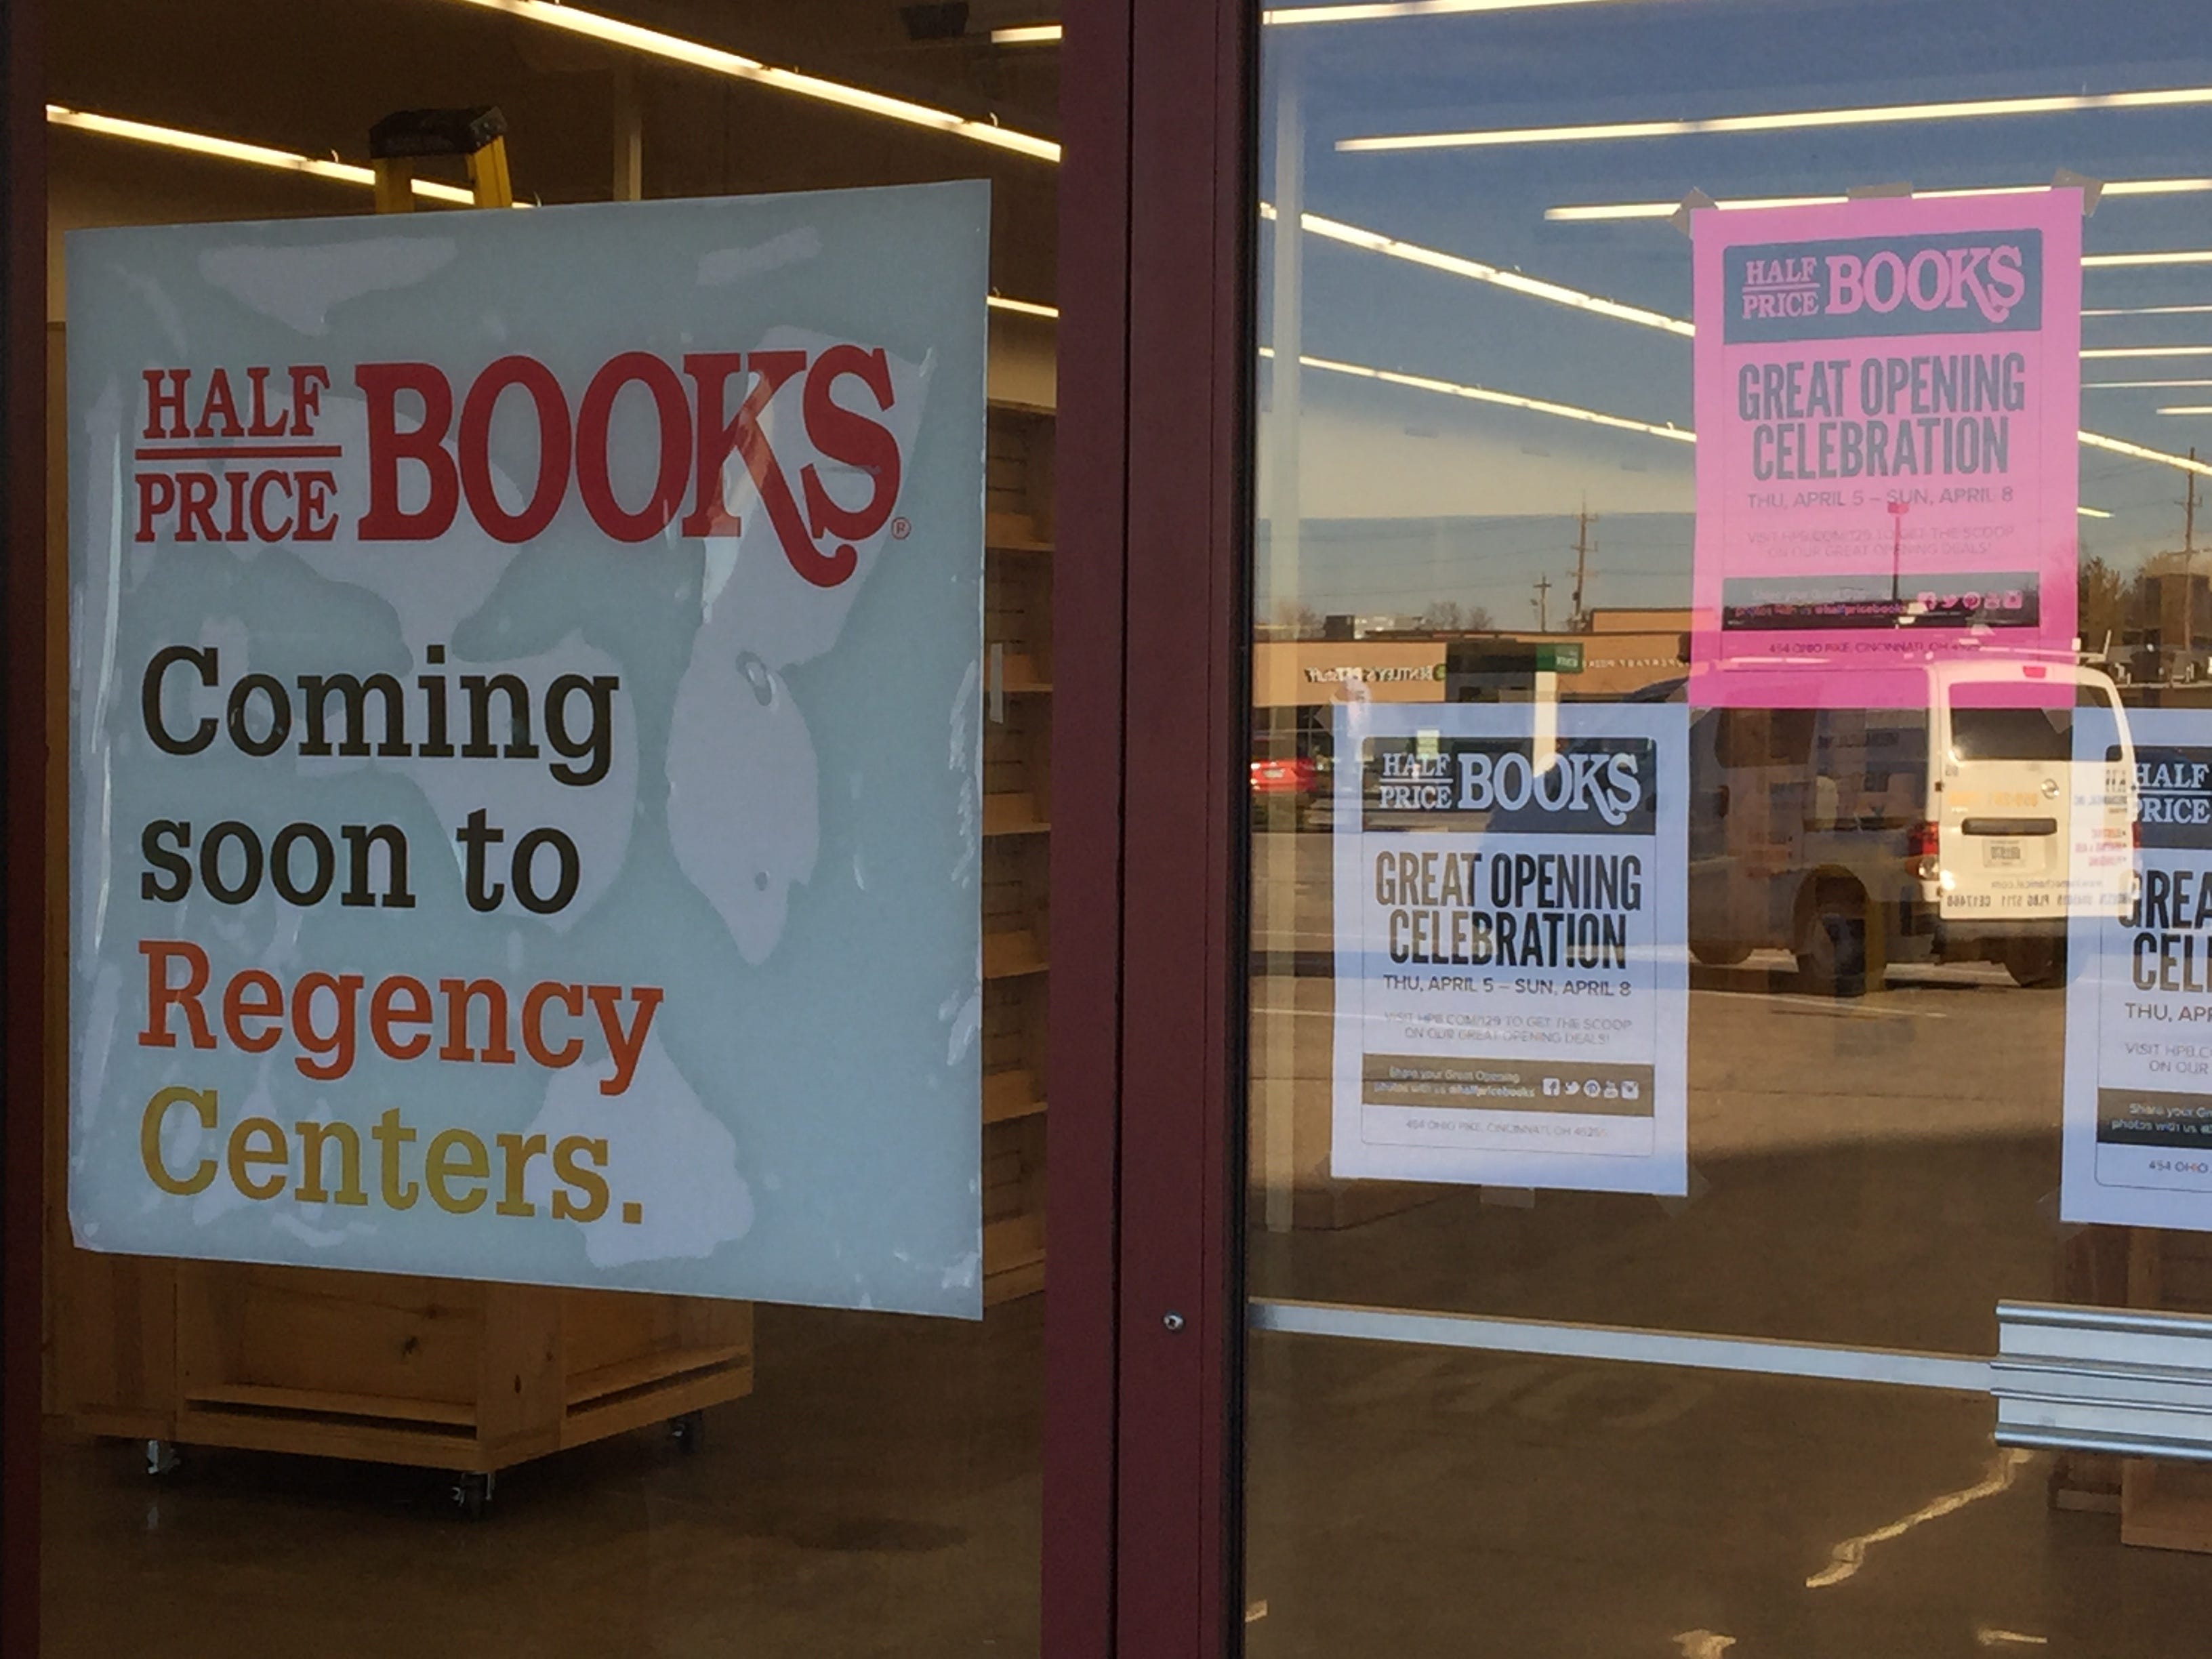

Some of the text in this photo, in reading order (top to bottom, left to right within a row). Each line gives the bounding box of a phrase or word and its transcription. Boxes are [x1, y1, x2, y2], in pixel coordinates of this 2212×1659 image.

[1746, 257, 1817, 284] HALF
[1825, 245, 2025, 323] BOOKS
[1742, 291, 1819, 319] PRICE
[142, 365, 331, 438] HALF
[1738, 352, 2026, 421] GREAT OPENING
[354, 344, 901, 588] BOOKS
[1753, 415, 2009, 481] CELEBRATION
[135, 470, 338, 543] PRICE
[1748, 493, 1788, 510] THU,
[1793, 491, 1845, 508] APRIL
[1851, 490, 1864, 506] 5
[1886, 488, 1933, 506] SUN,
[1939, 487, 1994, 504] APRIL
[2001, 486, 2014, 502] 8
[142, 644, 620, 787] Coming
[1382, 752, 1451, 777] HALF
[1457, 752, 1642, 827] BOOKS
[2134, 762, 2210, 788] HALF
[1379, 785, 1452, 809] PRICE
[2134, 798, 2211, 824] RICE
[140, 808, 580, 914] soon to
[1375, 851, 1641, 912] GREAT OPENING
[1389, 909, 1626, 969] CELEBRATION
[2133, 931, 2212, 993] CEL
[1383, 975, 1424, 993] THU,
[1427, 976, 1477, 992] APRIL
[1482, 977, 1494, 993] 5
[1515, 978, 1557, 996] SUN,
[1562, 980, 1614, 996] APRIL
[1619, 981, 1632, 996] 8
[2125, 1002, 2173, 1023] THU,
[138, 940, 664, 1096] Regency
[1583, 1019, 1633, 1031] SCOOP
[2125, 1042, 2160, 1055] VISIT
[2148, 1060, 2209, 1075] ON OUR
[140, 1086, 642, 1225] Centers.
